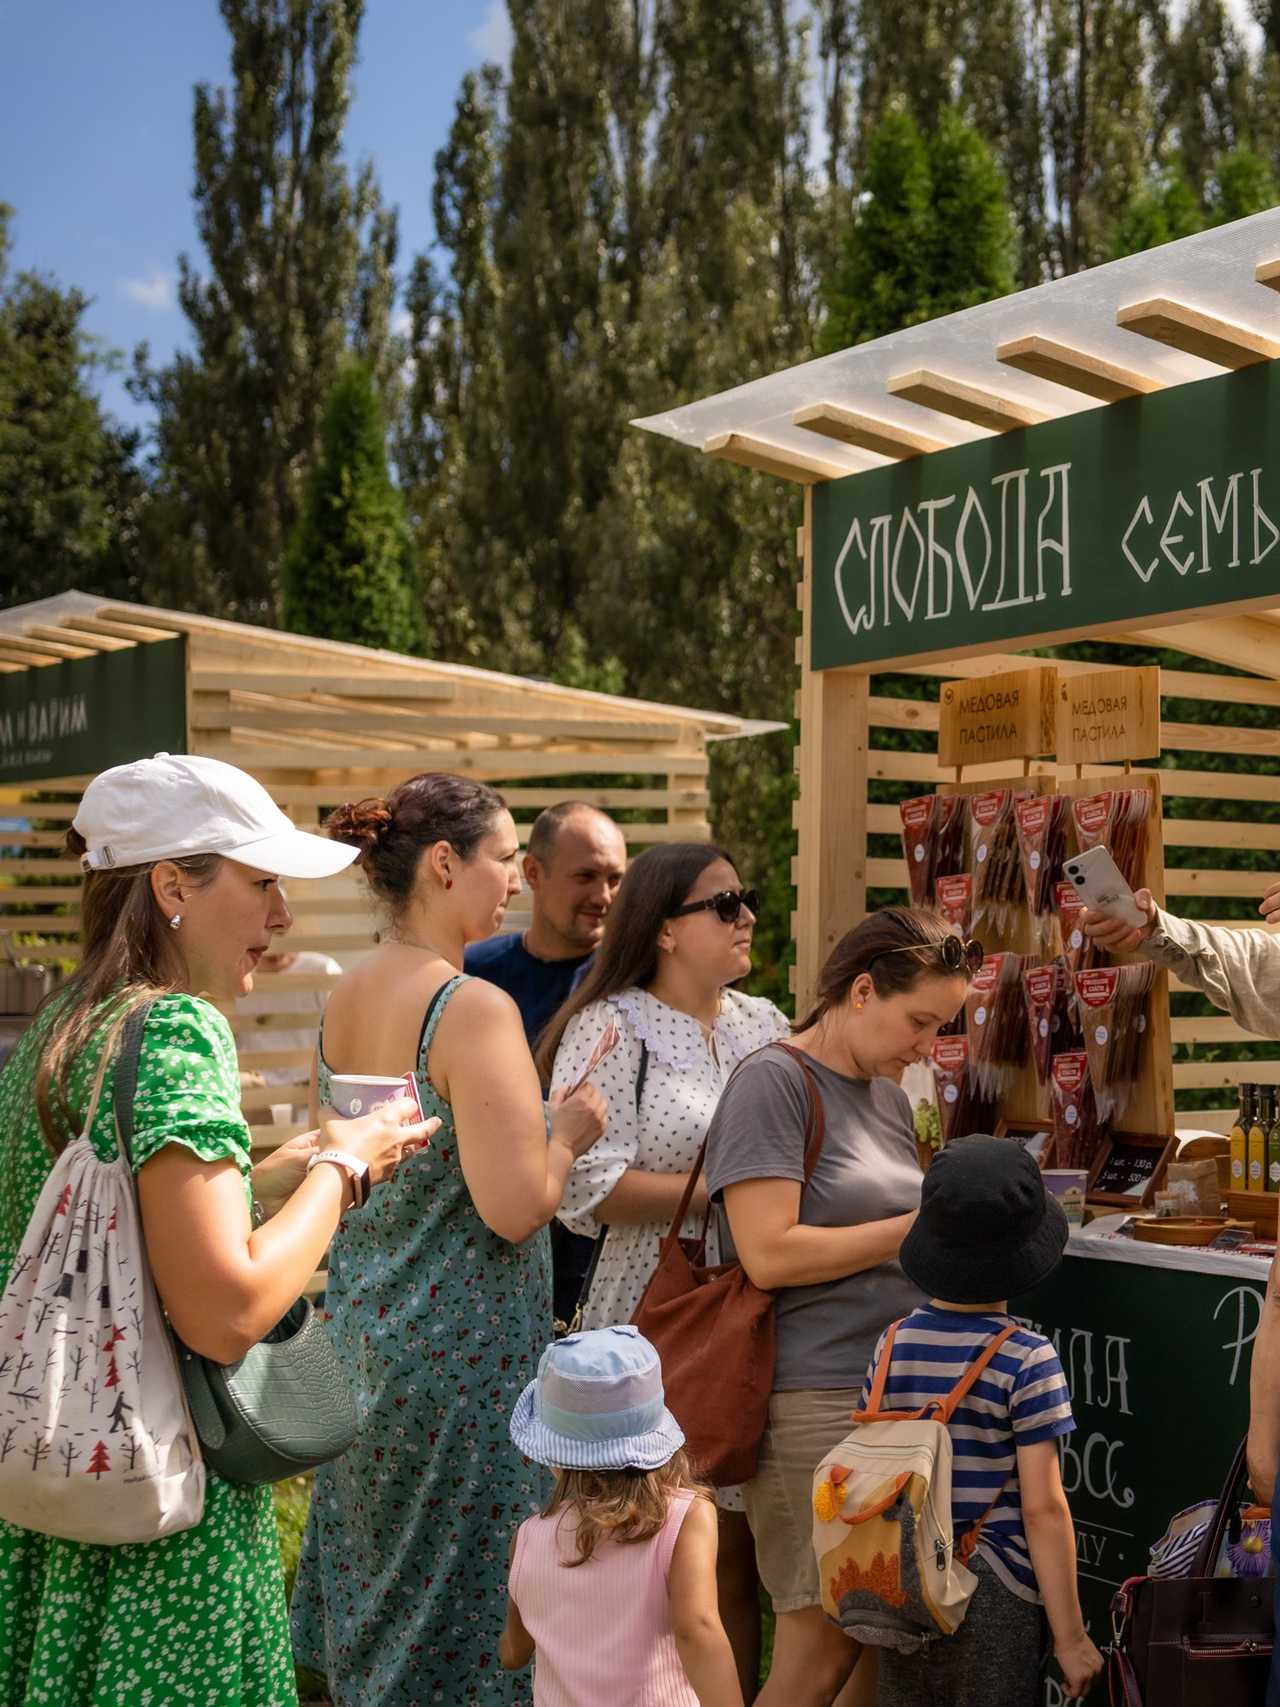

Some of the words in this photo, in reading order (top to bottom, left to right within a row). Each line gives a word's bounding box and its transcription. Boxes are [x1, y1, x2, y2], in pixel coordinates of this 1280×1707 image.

[834, 462, 1072, 635] СЛОБОДА
[959, 690, 1019, 716] МЕДОВАЯ
[1072, 696, 1127, 717] МЕДОВАЯ
[959, 725, 1018, 745] ПАСТИЛА
[1072, 724, 1127, 743] ПАСТИЛА
